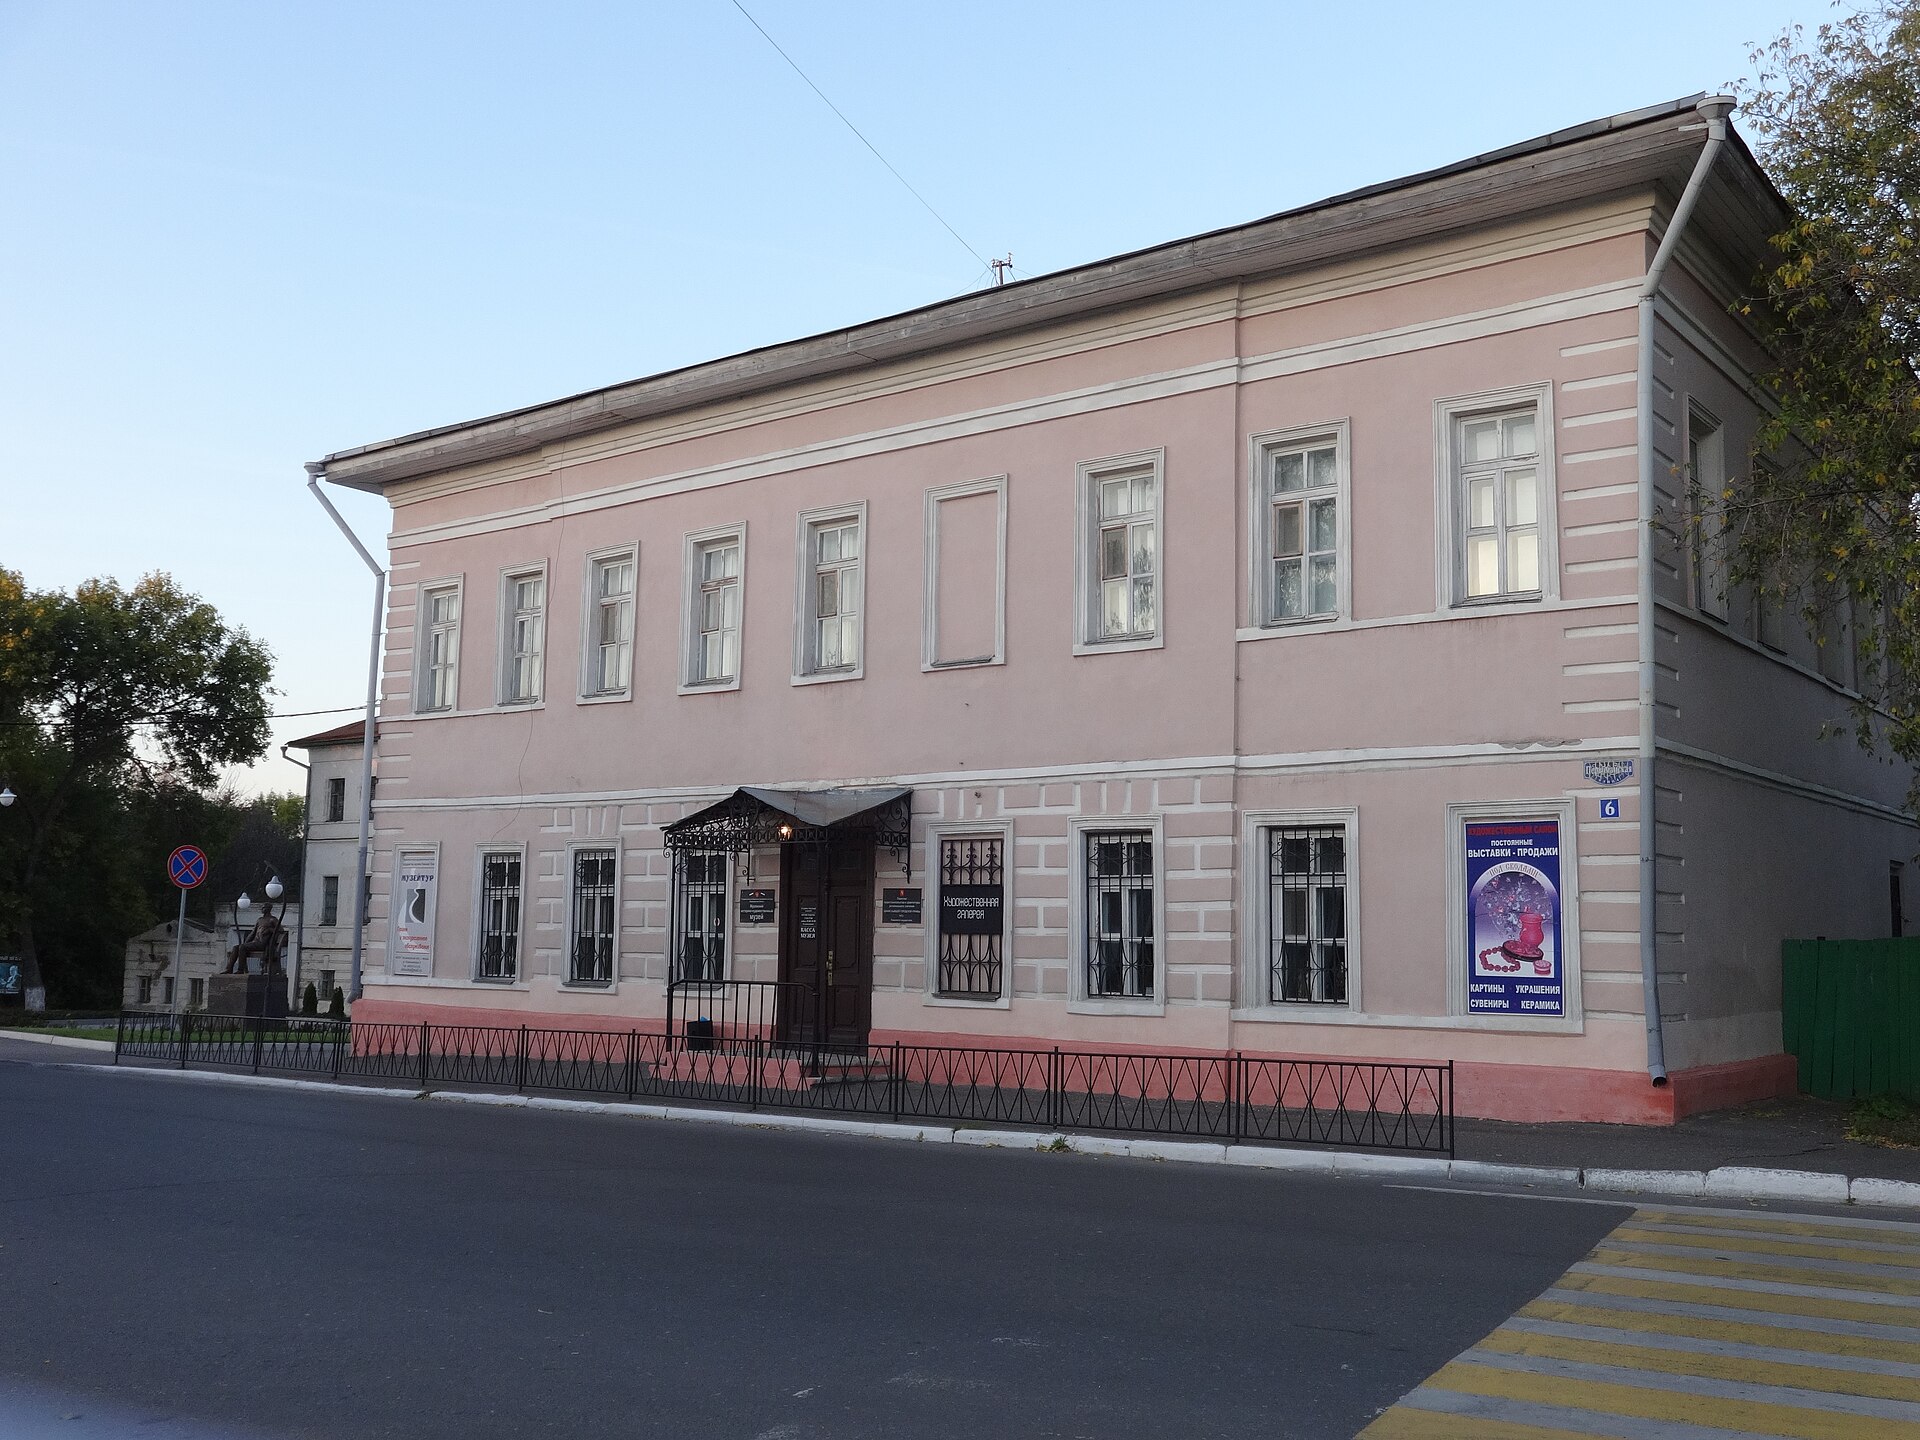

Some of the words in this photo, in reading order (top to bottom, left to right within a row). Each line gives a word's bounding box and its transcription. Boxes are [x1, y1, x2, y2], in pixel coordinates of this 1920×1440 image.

[1605, 801, 1615, 815] 6
[1468, 848, 1511, 858] ВЫСТАВКИ
[1517, 847, 1558, 858] ПРОДАЖИ
[1470, 983, 1505, 993] КАРТИНЫ
[1515, 984, 1561, 995] УКРАШЕНИЯ
[1470, 999, 1509, 1008] СУВЕНИРЫ
[1521, 1000, 1560, 1010] КЕРАМИКА
